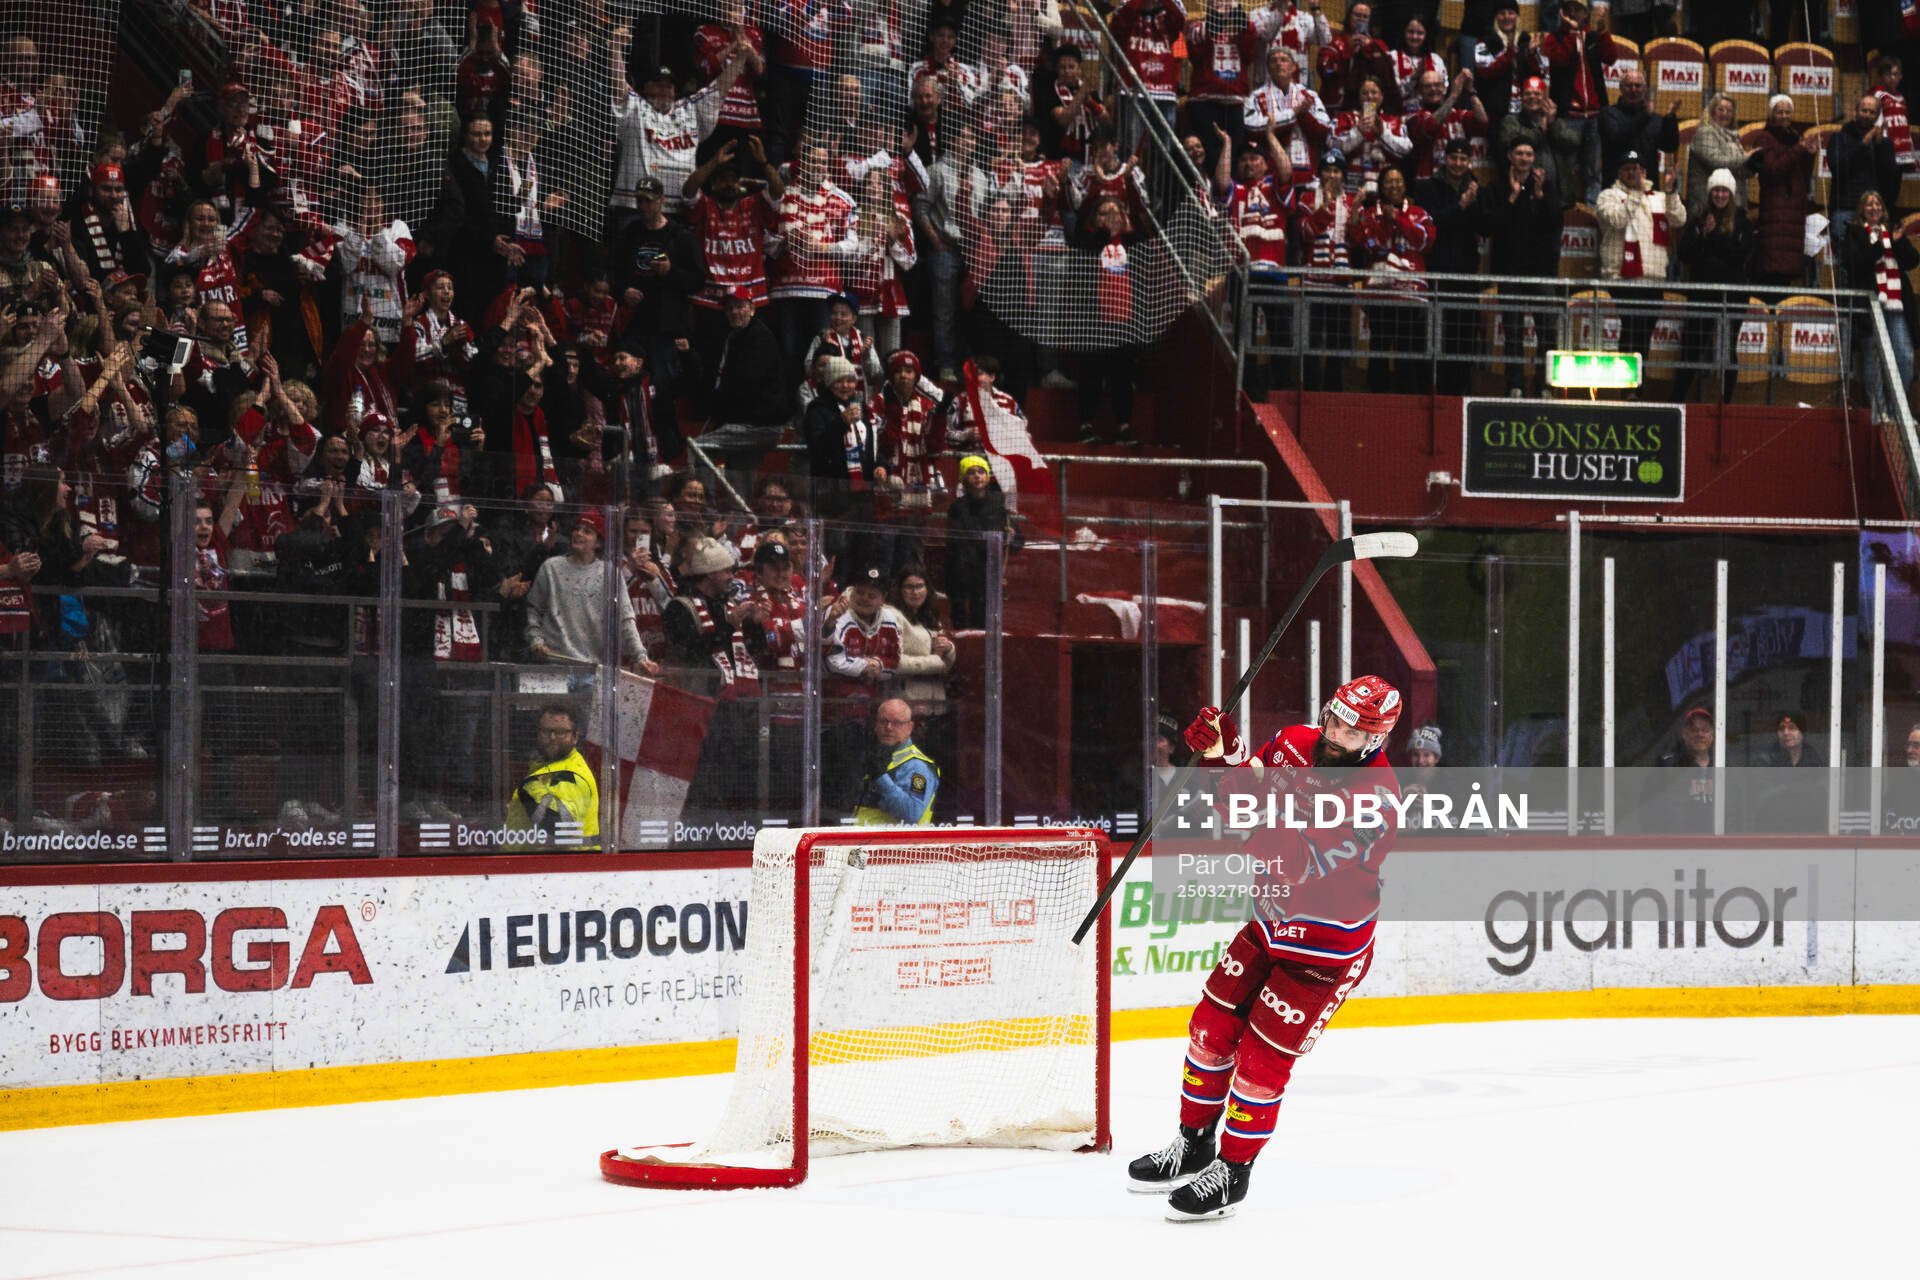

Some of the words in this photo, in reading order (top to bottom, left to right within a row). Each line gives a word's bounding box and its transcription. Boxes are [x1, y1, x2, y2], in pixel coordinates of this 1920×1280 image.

[1661, 67, 1699, 84] MAXI
[1729, 70, 1766, 84] MAXI
[1738, 331, 1765, 344] AXI
[1484, 416, 1662, 451] GRÖNSAKS
[1531, 452, 1639, 482] HUSET
[3, 831, 138, 851] brandcode.se
[225, 827, 347, 848] branode.se
[458, 825, 548, 846] Brandcode
[506, 900, 748, 969] EUROCON
[1484, 868, 1798, 977] granitor
[1112, 946, 1136, 976] &
[560, 984, 615, 1012] PART
[624, 982, 652, 1006] OF
[1259, 985, 1306, 1025] coop
[50, 1032, 102, 1054] BYGG
[112, 1022, 288, 1050] BEKYMMERSFRITT
